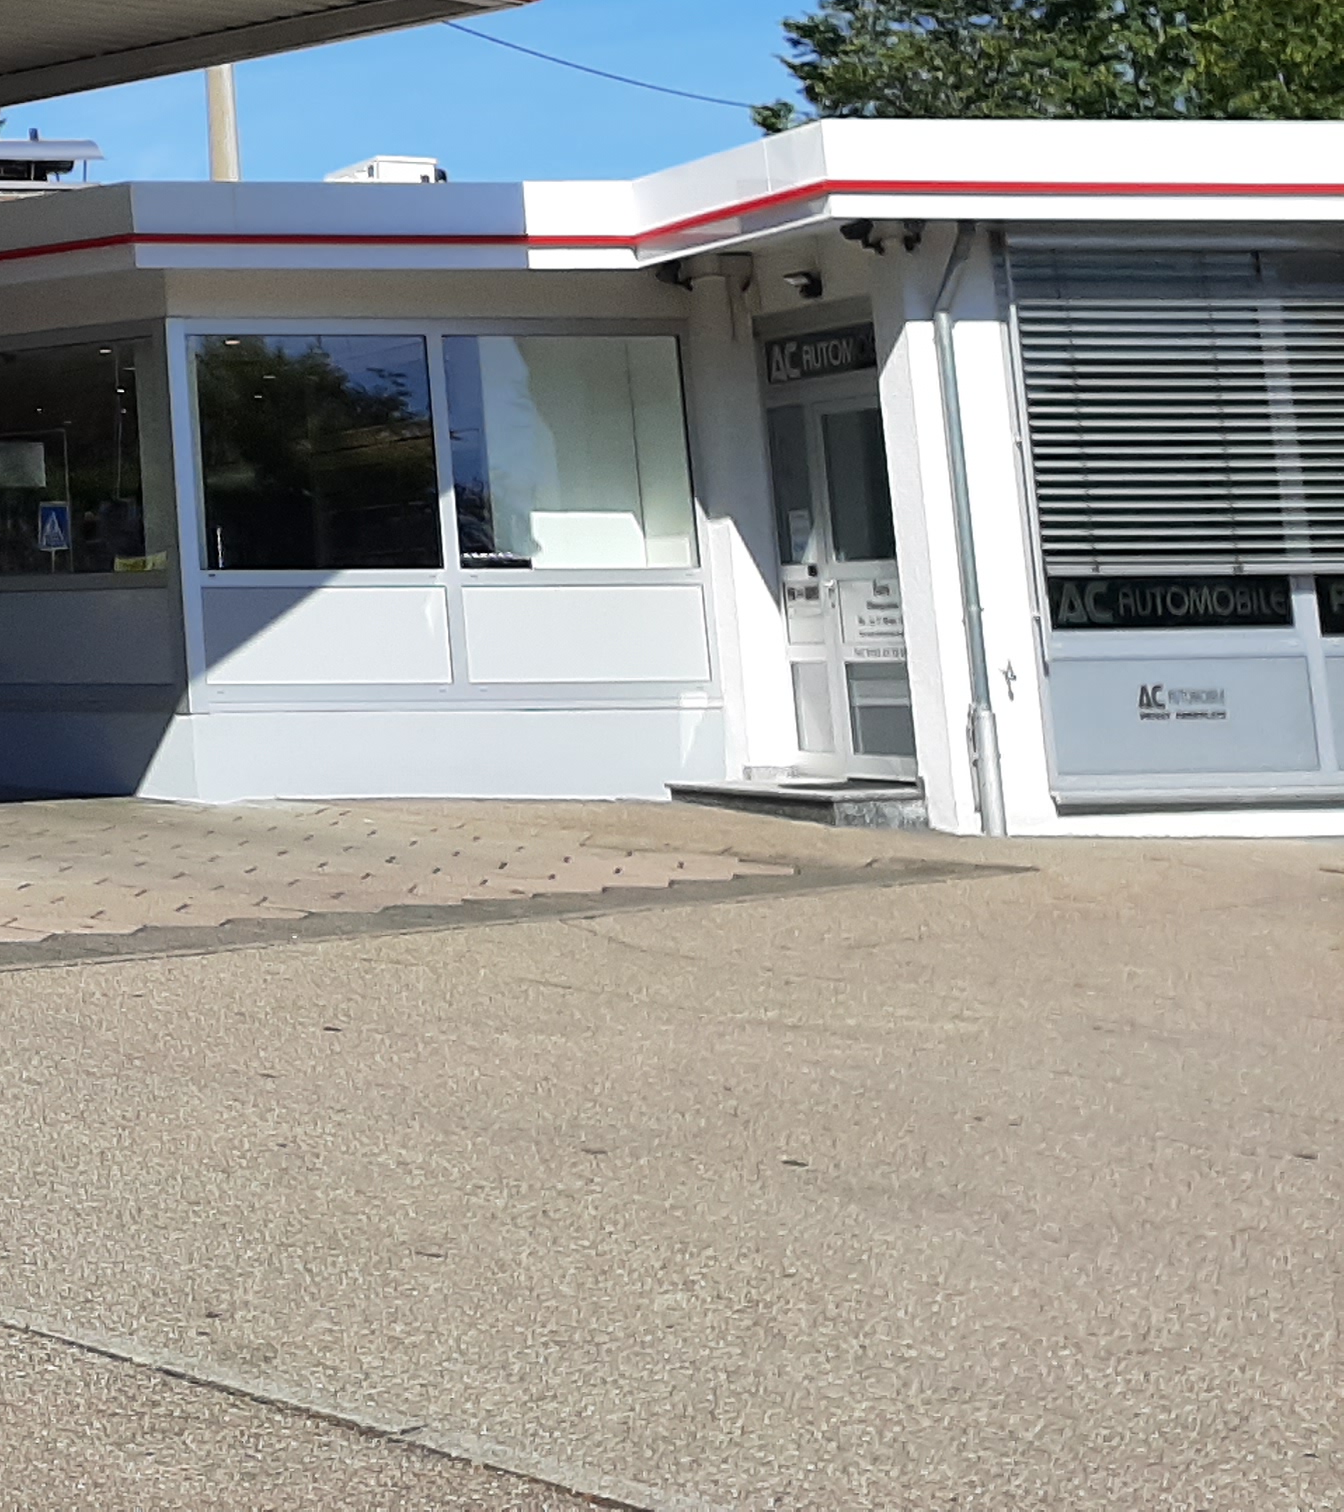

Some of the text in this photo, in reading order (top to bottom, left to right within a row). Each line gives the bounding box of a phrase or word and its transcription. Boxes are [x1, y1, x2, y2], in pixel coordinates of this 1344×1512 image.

[771, 341, 802, 382] AC
[1058, 581, 1113, 623] AC
[1118, 584, 1288, 617] AUTOMOBILE
[1138, 684, 1166, 709] AC
